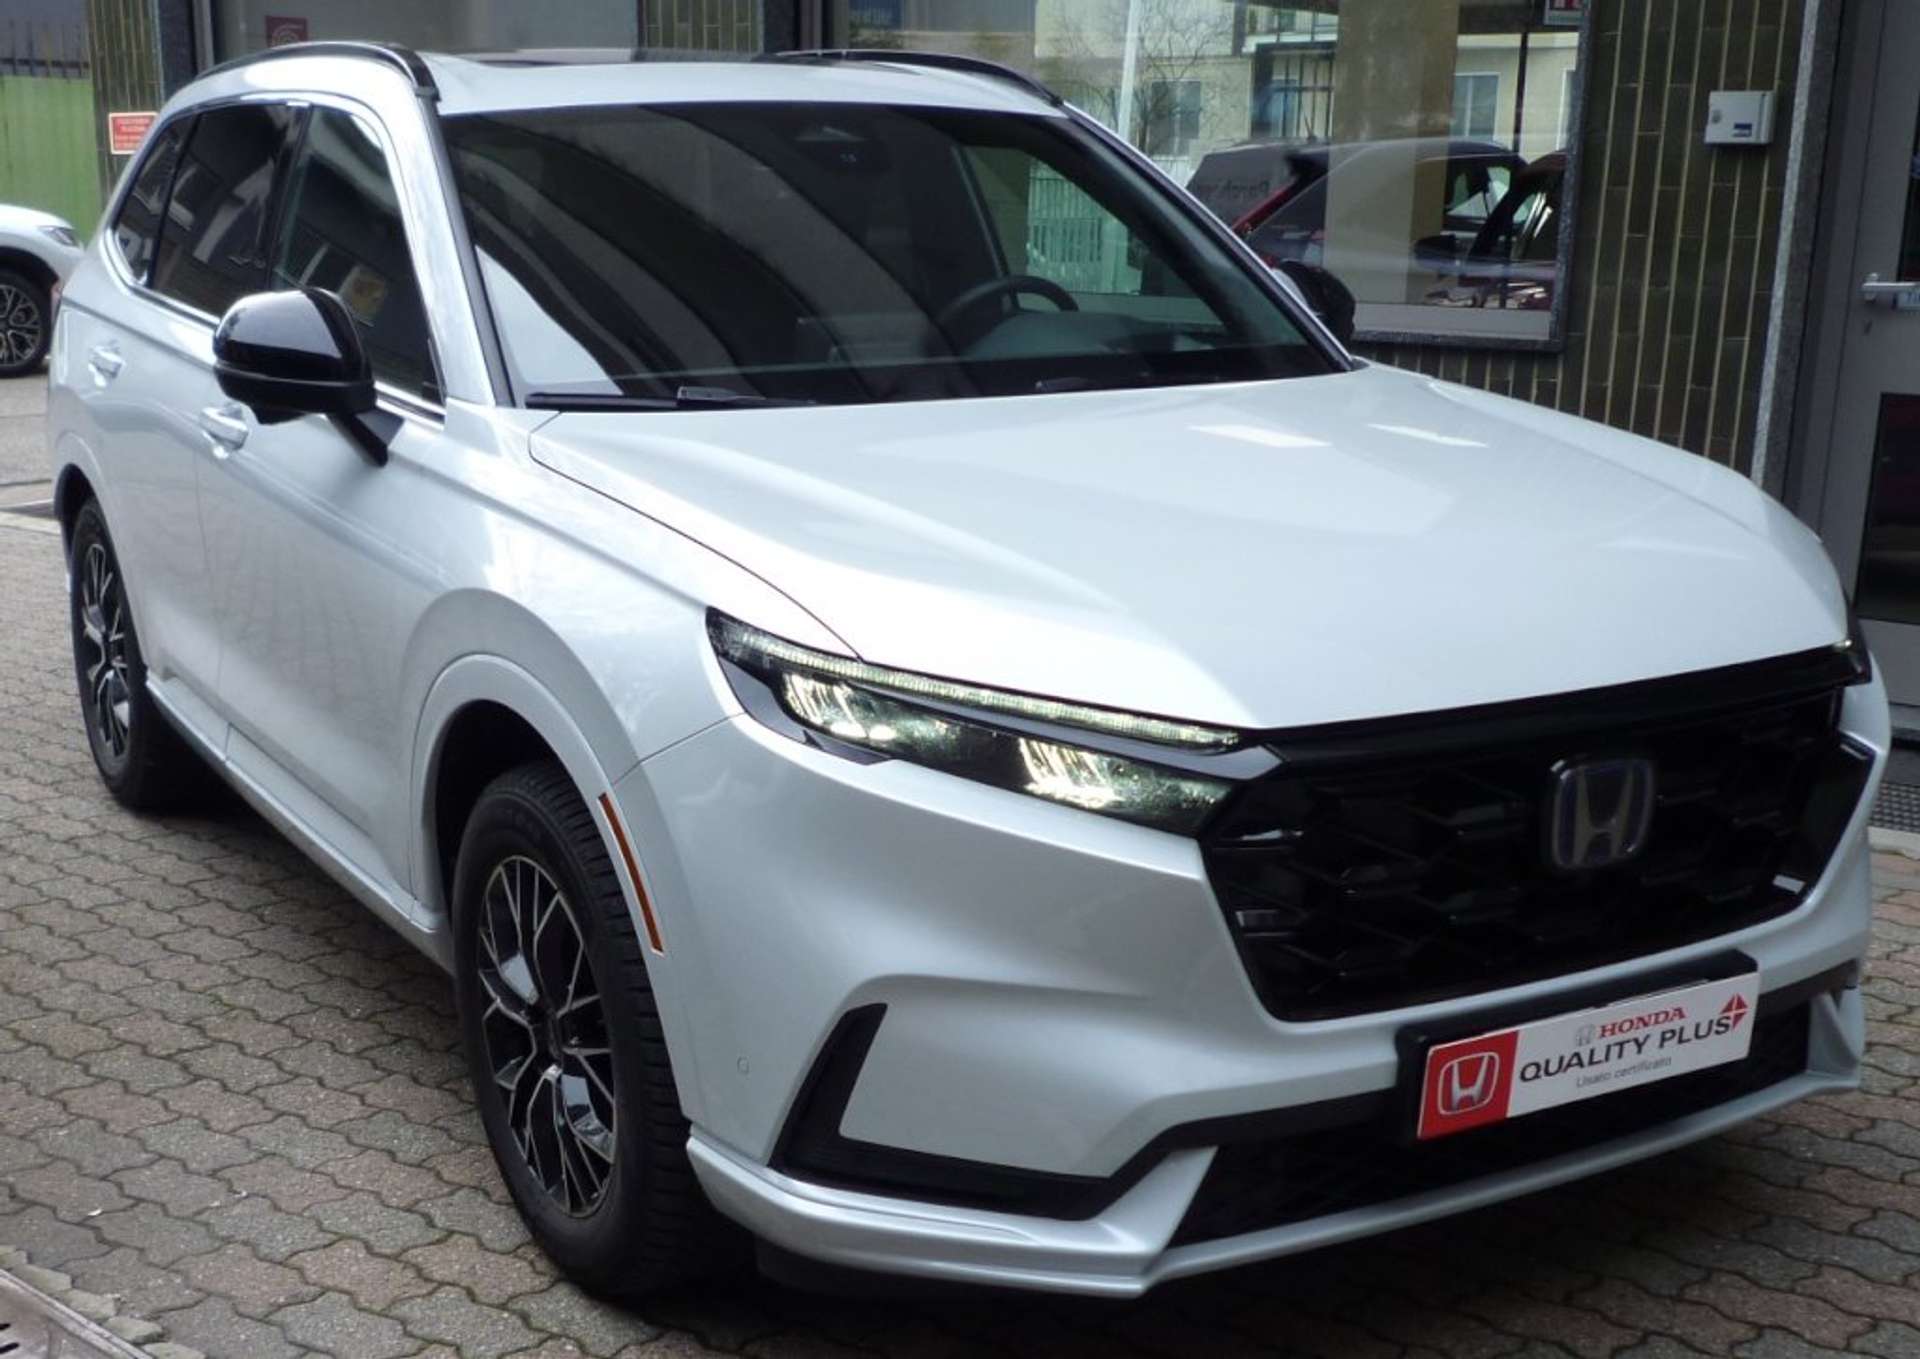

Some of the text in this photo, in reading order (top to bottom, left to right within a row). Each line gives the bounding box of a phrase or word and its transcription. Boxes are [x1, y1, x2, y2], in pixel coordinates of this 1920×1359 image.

[1599, 1007, 1687, 1039] HONDA
[1519, 1034, 1651, 1083] QUALITY
[1658, 1015, 1732, 1049] PLUS
[1613, 1056, 1673, 1080] certificato
